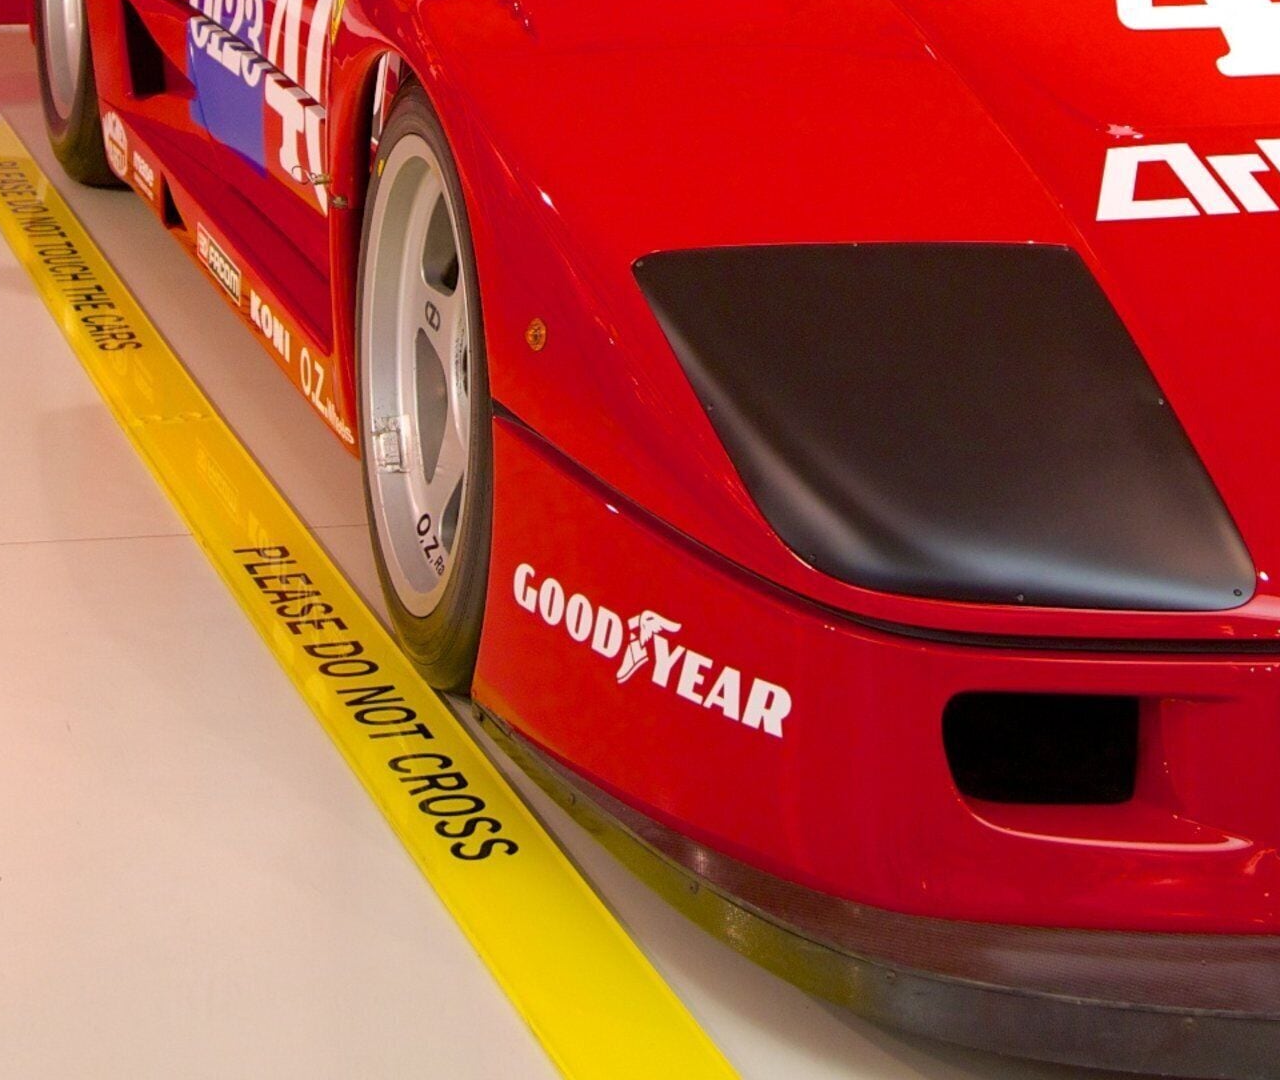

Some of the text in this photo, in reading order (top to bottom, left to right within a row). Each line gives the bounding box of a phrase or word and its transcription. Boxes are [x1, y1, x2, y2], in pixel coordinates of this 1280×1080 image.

[6, 198, 50, 214] DO
[16, 216, 68, 239] NOT
[33, 240, 97, 283] TOUCH
[62, 284, 116, 312] THE
[80, 313, 143, 352] CARS
[249, 288, 291, 364] KONI
[232, 545, 519, 861] PLEASE DO NOT CROSS
